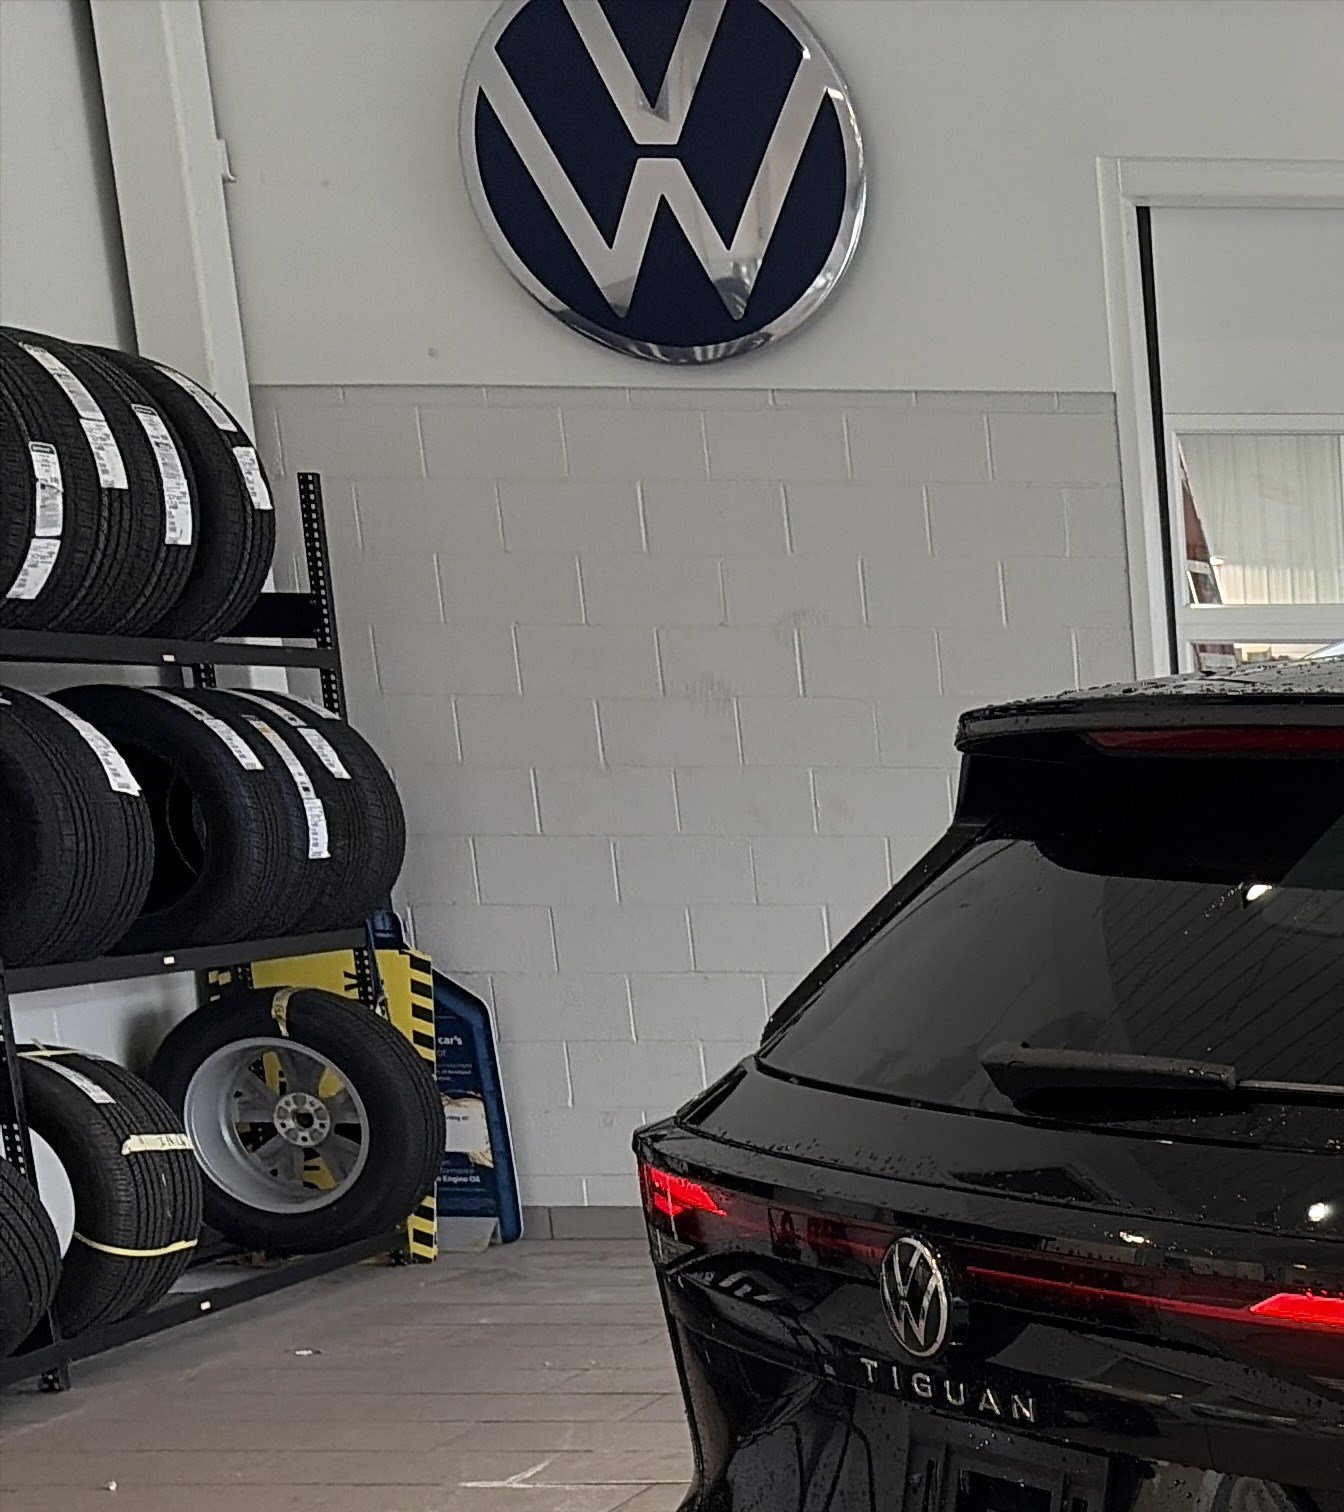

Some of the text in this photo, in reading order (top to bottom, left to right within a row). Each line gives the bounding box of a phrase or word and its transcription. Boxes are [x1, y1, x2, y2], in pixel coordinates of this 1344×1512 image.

[437, 1035, 463, 1045] car's
[881, 1237, 948, 1357] VW
[860, 1357, 1035, 1423] TIGUAN
